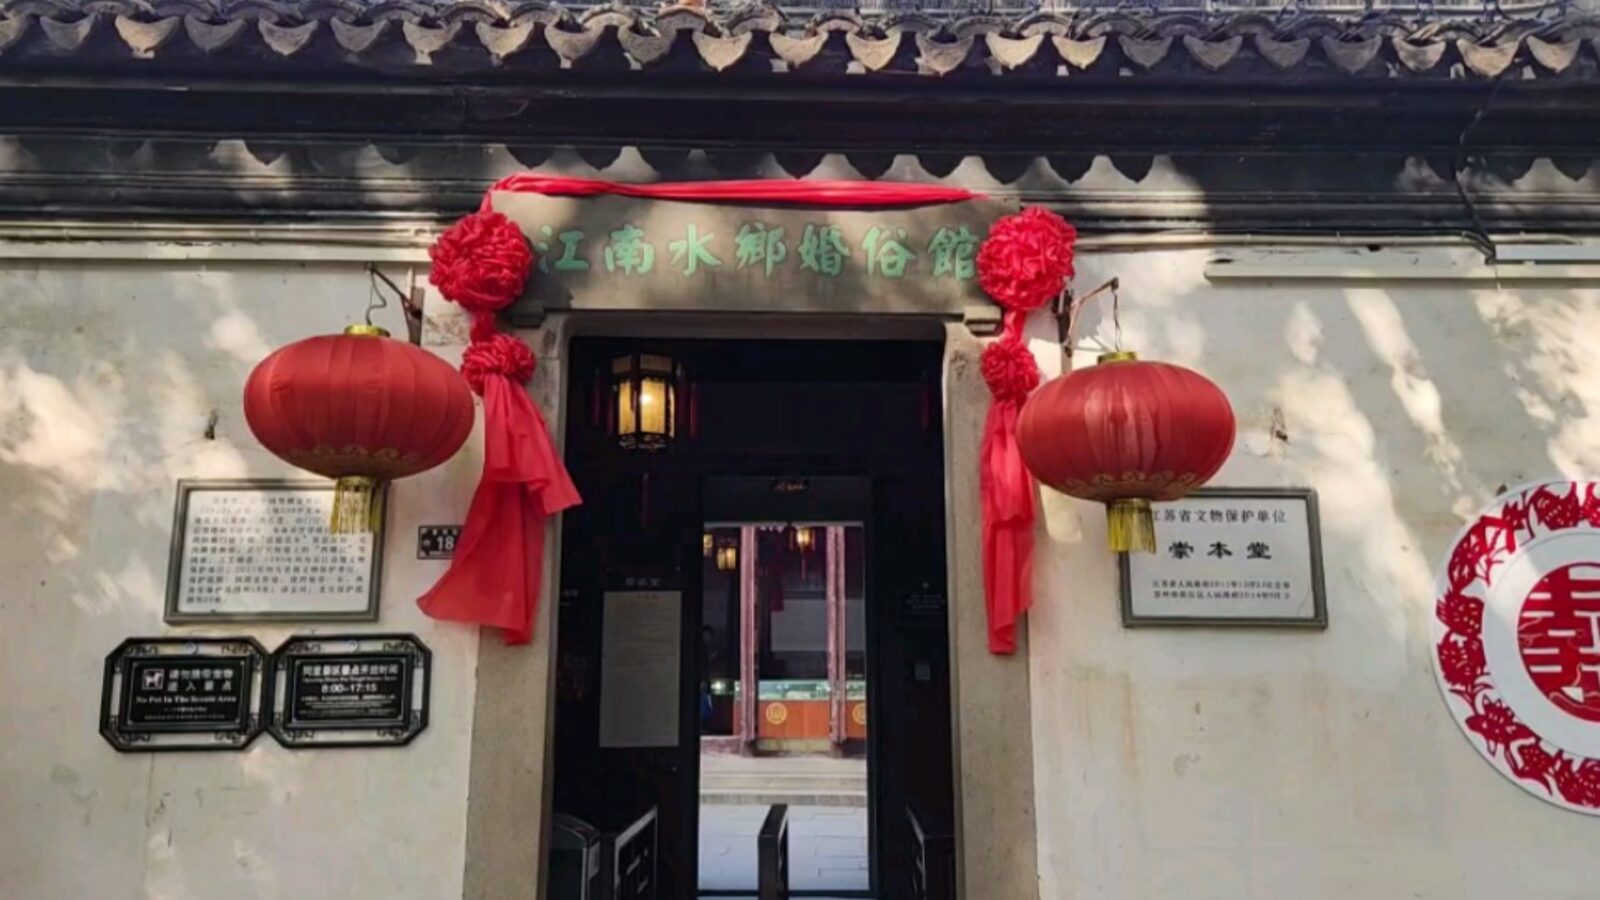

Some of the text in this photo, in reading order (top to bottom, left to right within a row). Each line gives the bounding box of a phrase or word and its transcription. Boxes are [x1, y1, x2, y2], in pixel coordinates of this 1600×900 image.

[538, 222, 979, 280] 江南水鄉婚俗館
[436, 536, 454, 550] 18
